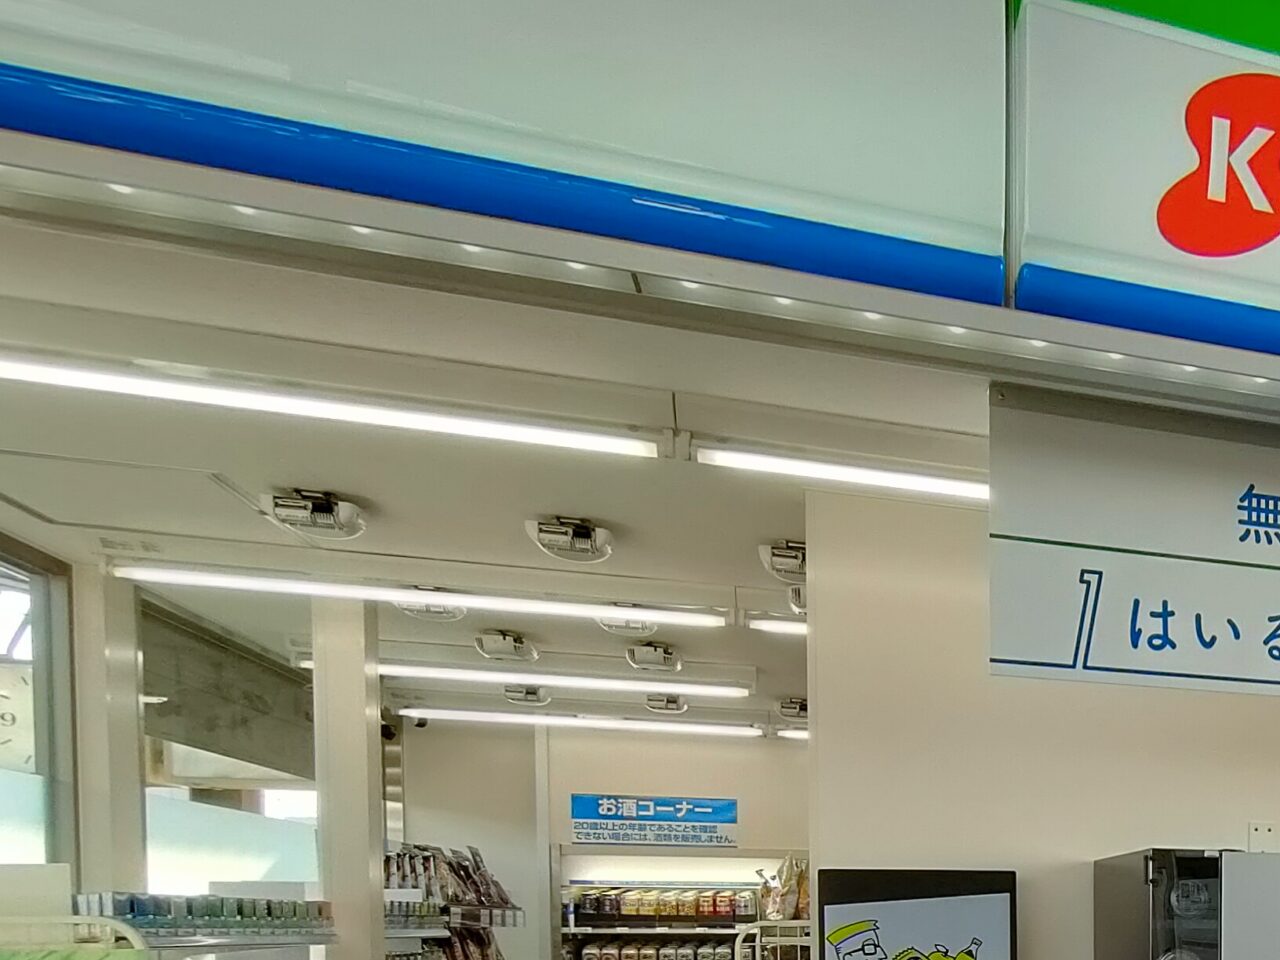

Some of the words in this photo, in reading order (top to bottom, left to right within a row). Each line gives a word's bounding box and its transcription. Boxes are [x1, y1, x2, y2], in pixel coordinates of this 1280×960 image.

[1207, 115, 1275, 215] K
[597, 798, 714, 818] お酒コーナー
[573, 821, 718, 834] 20歳以上の年齢であることを確認
